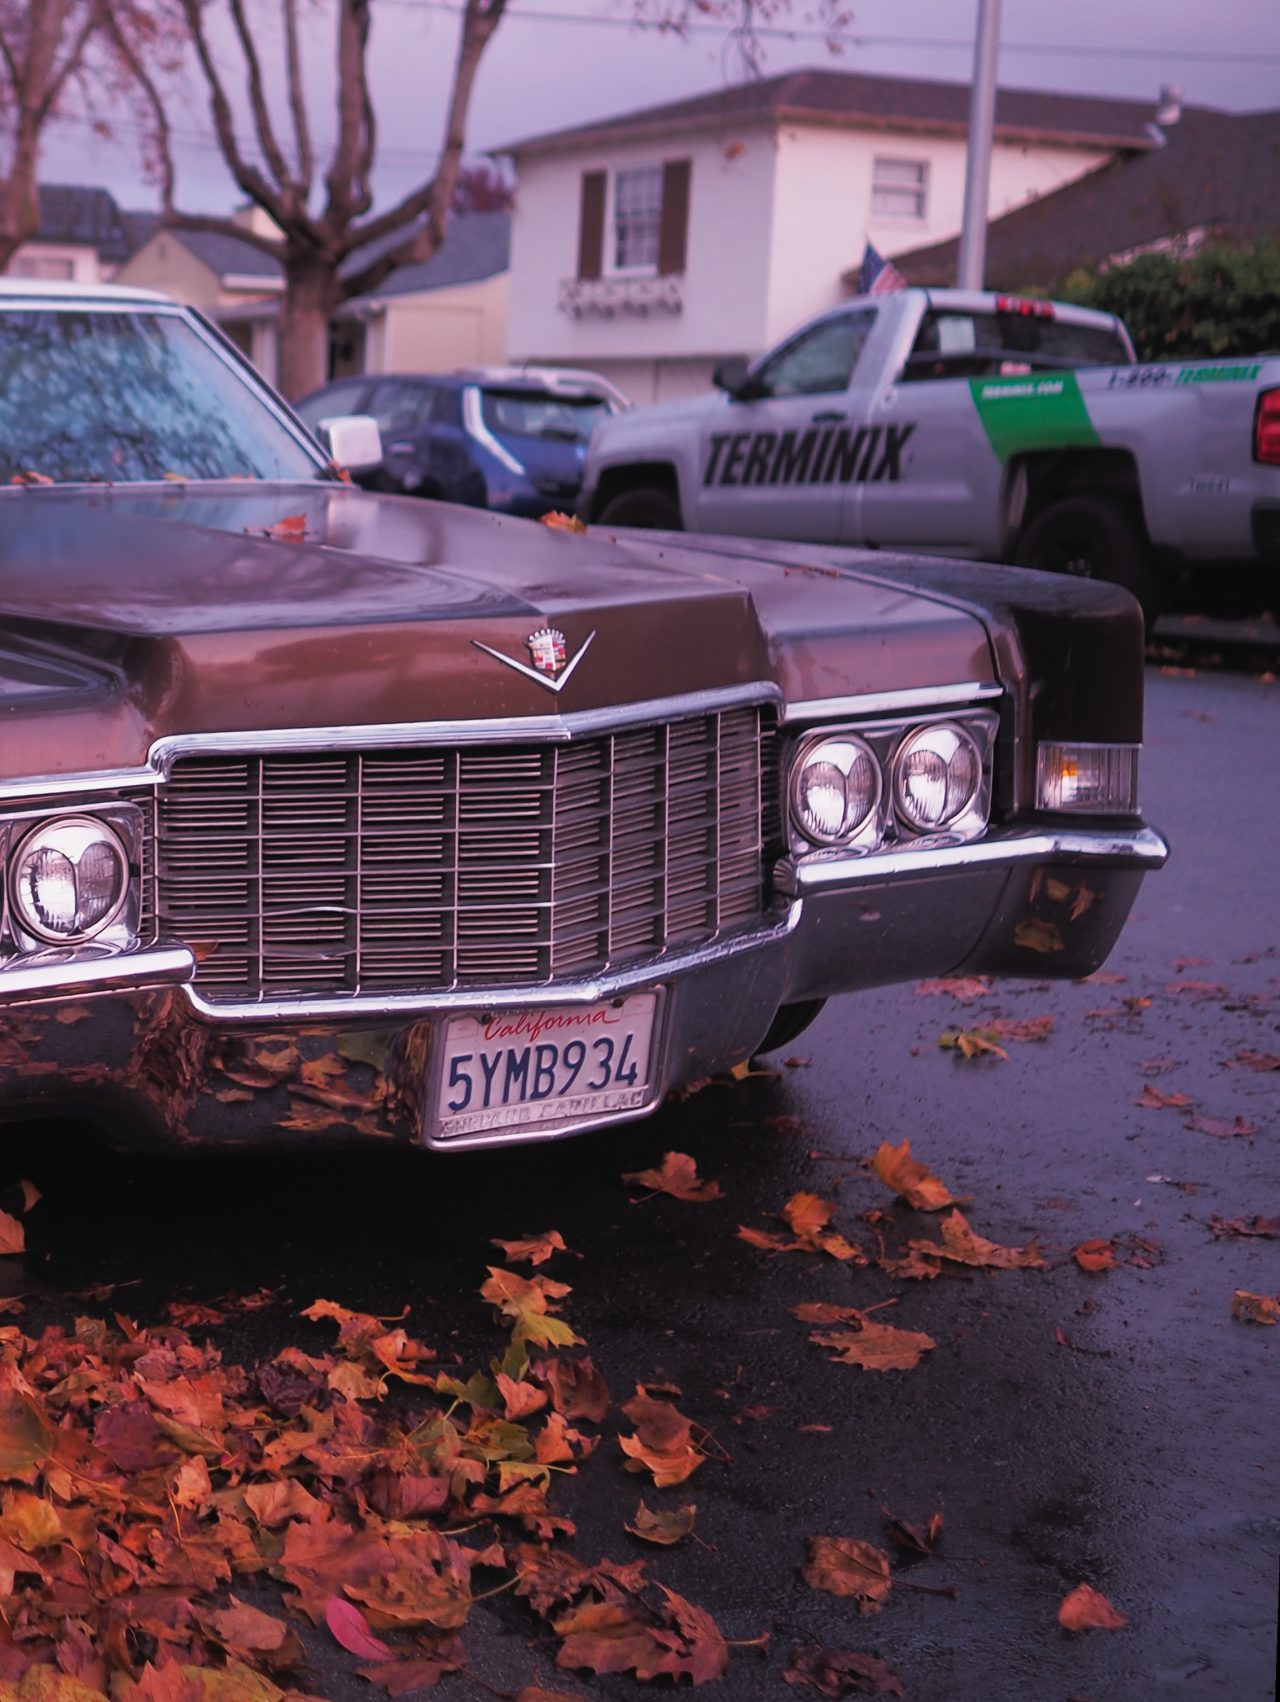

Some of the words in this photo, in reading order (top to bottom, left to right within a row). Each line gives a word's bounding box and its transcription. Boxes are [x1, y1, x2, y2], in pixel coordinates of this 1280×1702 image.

[703, 423, 916, 486] TERMINIX
[484, 1009, 620, 1042] California
[448, 1033, 638, 1112] 5YMB934
